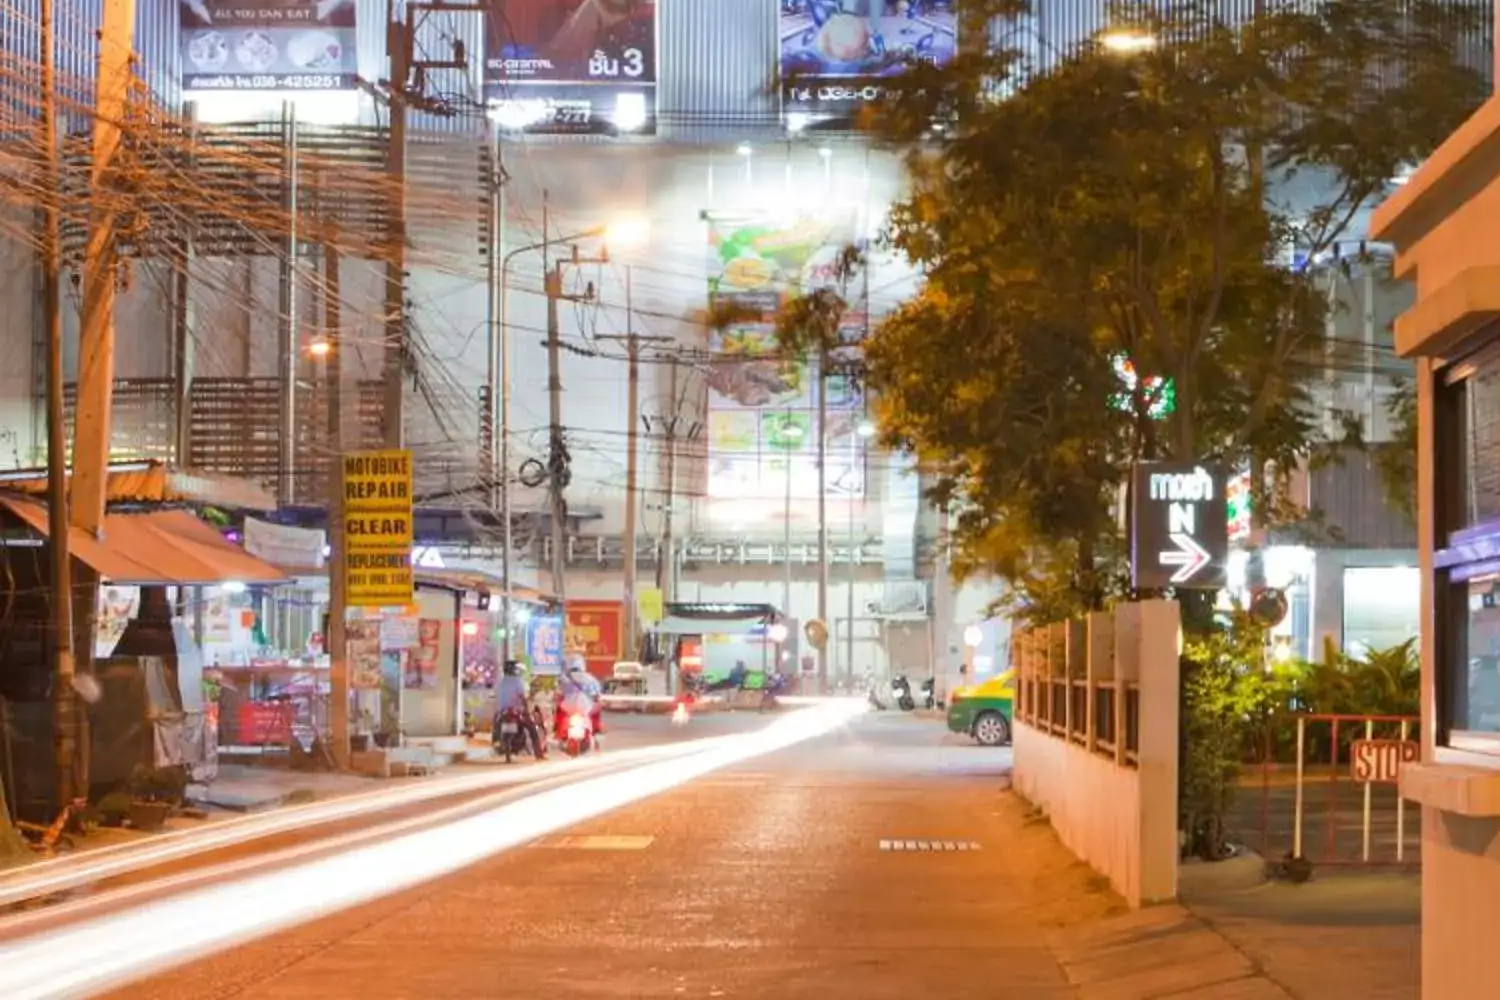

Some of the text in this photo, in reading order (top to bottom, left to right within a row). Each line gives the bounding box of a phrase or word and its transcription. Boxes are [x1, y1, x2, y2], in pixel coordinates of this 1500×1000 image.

[623, 47, 644, 77] 3
[346, 481, 407, 499] REPAIR
[346, 518, 407, 535] CLEAR
